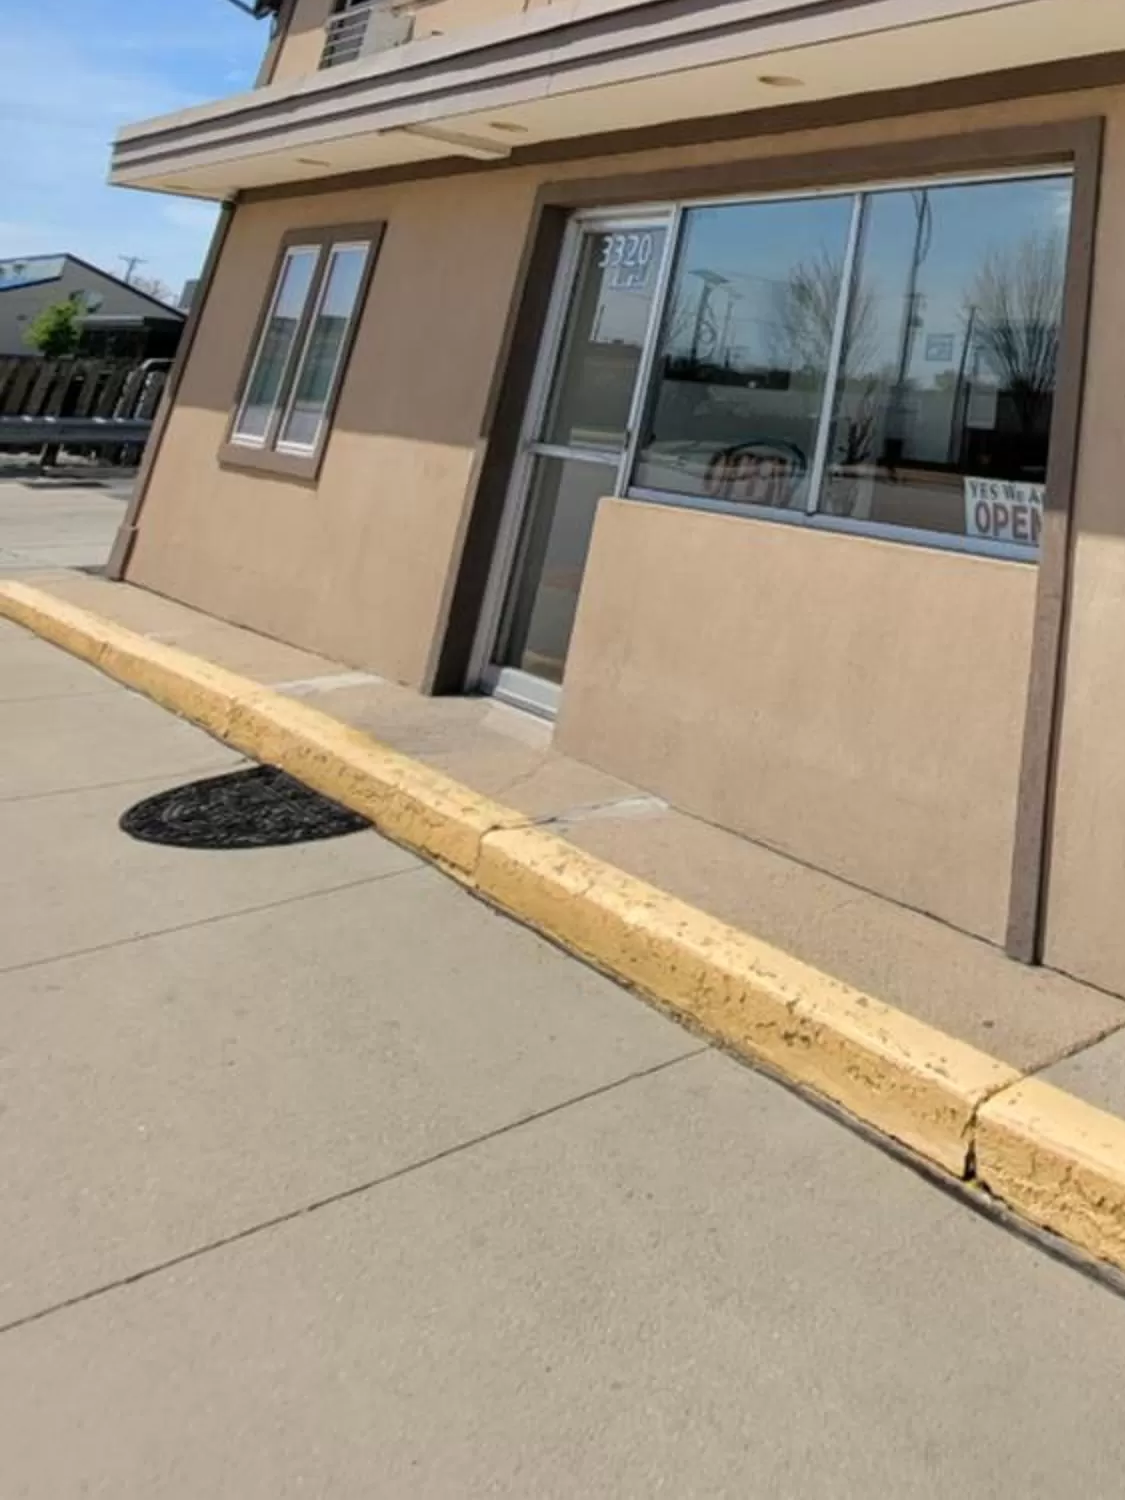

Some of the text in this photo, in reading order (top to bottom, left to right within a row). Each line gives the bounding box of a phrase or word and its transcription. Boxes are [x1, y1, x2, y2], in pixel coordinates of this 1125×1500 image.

[598, 233, 652, 268] 3320
[969, 481, 998, 500] YES
[975, 500, 1042, 542] OPEN
